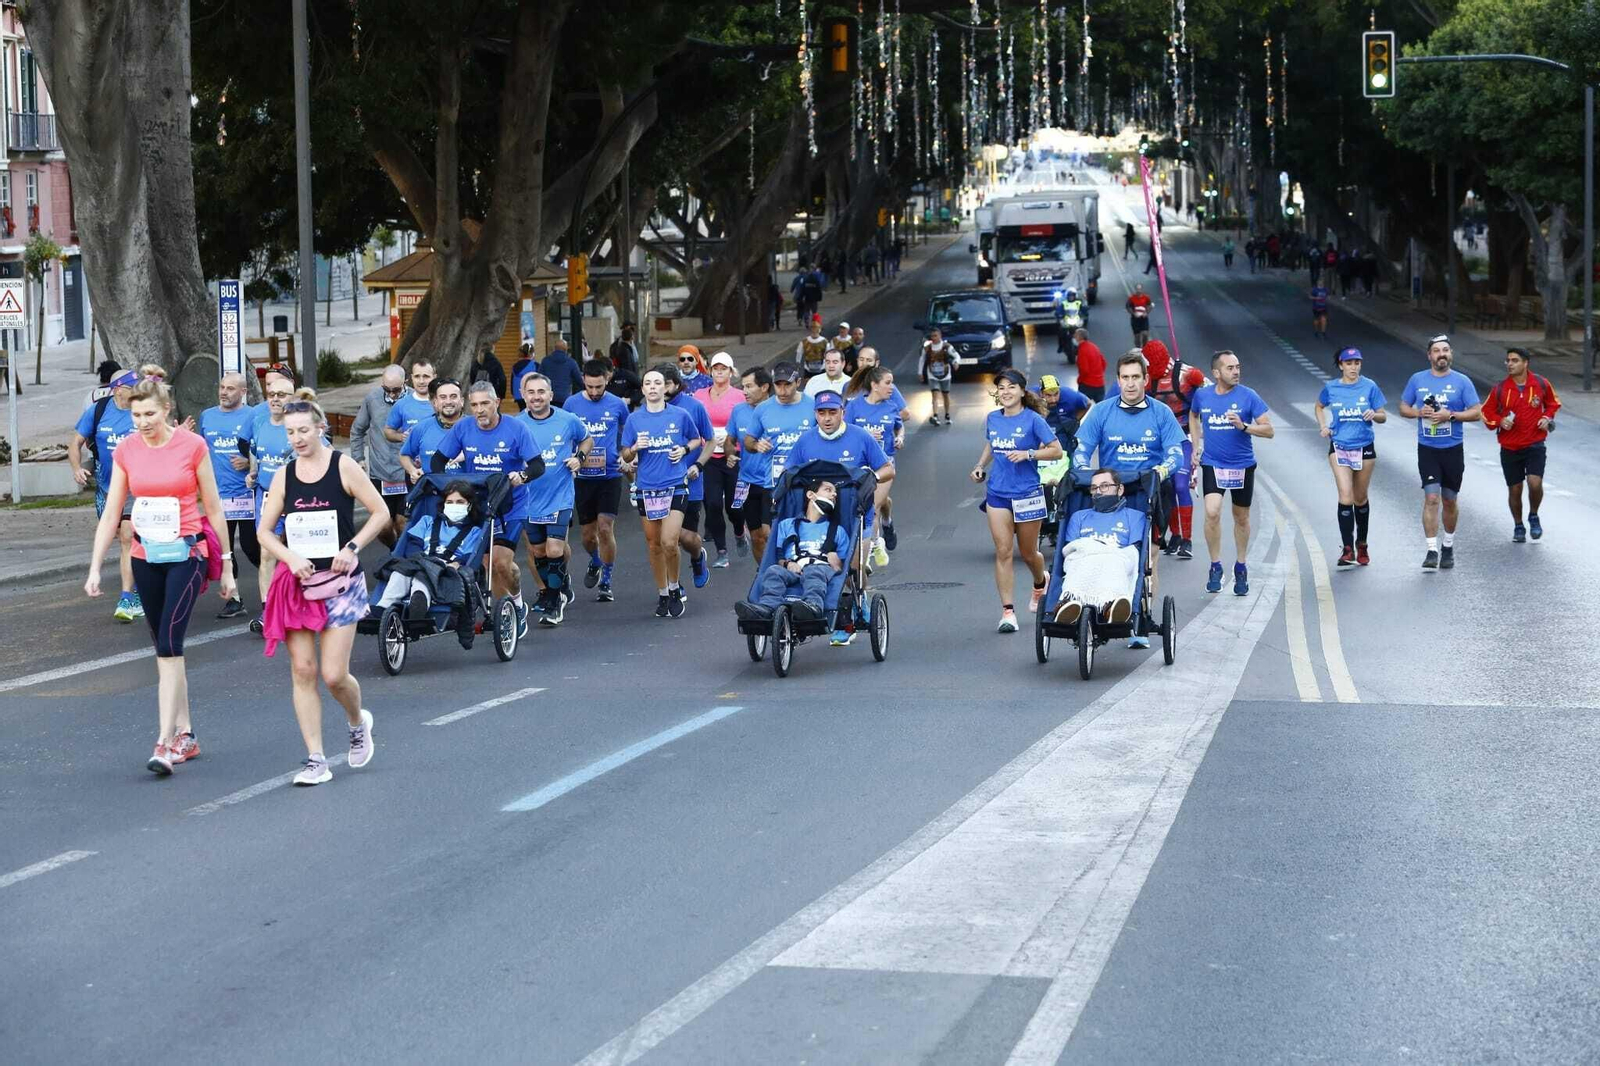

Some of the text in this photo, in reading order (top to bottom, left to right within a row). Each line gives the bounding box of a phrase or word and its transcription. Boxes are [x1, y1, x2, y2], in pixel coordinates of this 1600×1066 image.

[220, 285, 238, 298] BUS
[223, 313, 235, 322] 32
[223, 323, 235, 332] 35
[223, 334, 235, 343] 36
[308, 529, 329, 537] 9402
